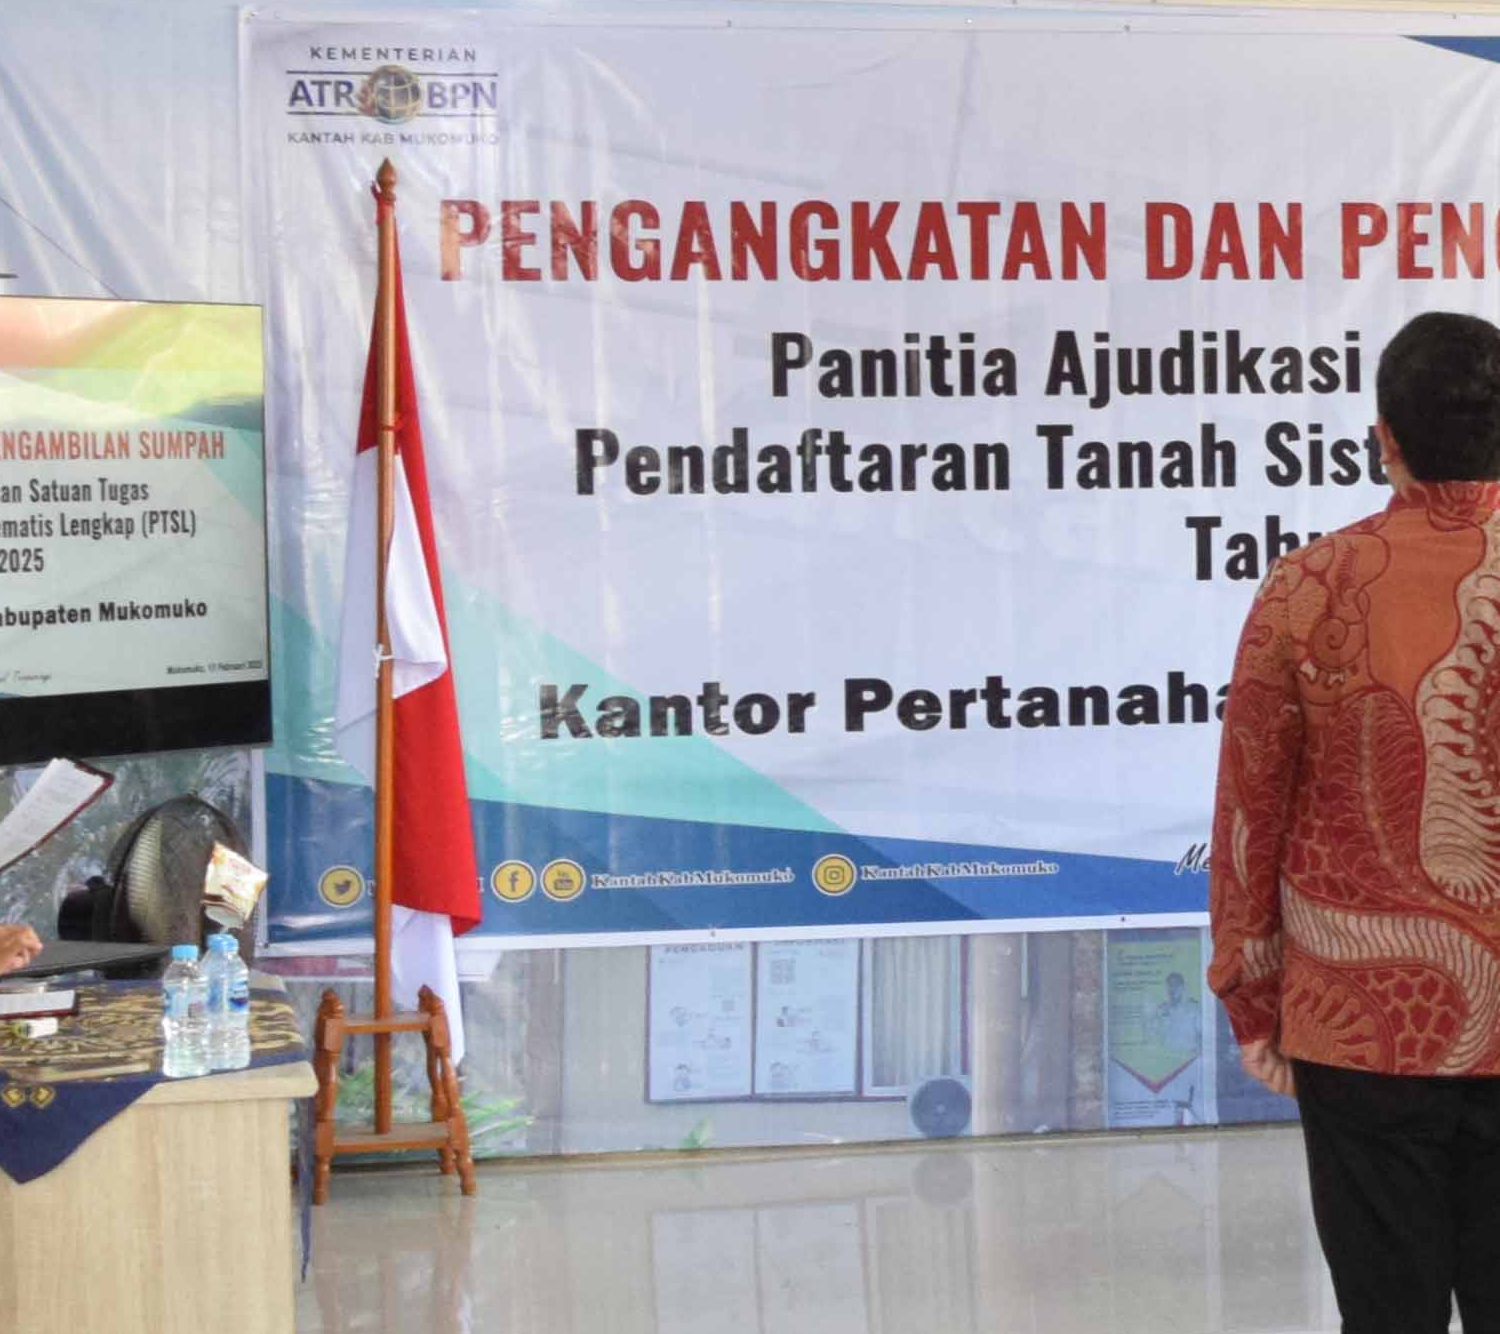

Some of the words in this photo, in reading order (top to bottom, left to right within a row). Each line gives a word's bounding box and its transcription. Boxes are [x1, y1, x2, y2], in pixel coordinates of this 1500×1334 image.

[310, 47, 476, 61] KEMENTERIAN
[288, 80, 354, 107] ATR
[428, 82, 498, 109] BPN
[288, 132, 355, 145] KANTAH
[360, 133, 395, 145] KAB
[440, 199, 1106, 282] PENGANGKATAN
[1145, 200, 1301, 280] DAN
[772, 331, 1017, 397] Panitia
[1044, 330, 1361, 408] Ajudikasi
[140, 430, 225, 460] SUMPAH
[575, 427, 1010, 495] Pendaftaran
[1036, 423, 1237, 489] Tanah
[29, 478, 92, 503] Satuan
[98, 477, 150, 507] Tugas
[60, 511, 134, 542] Lengkap
[142, 510, 197, 539] (PTSL)
[99, 598, 208, 622] Mukomuko
[539, 682, 816, 740] Kantor
